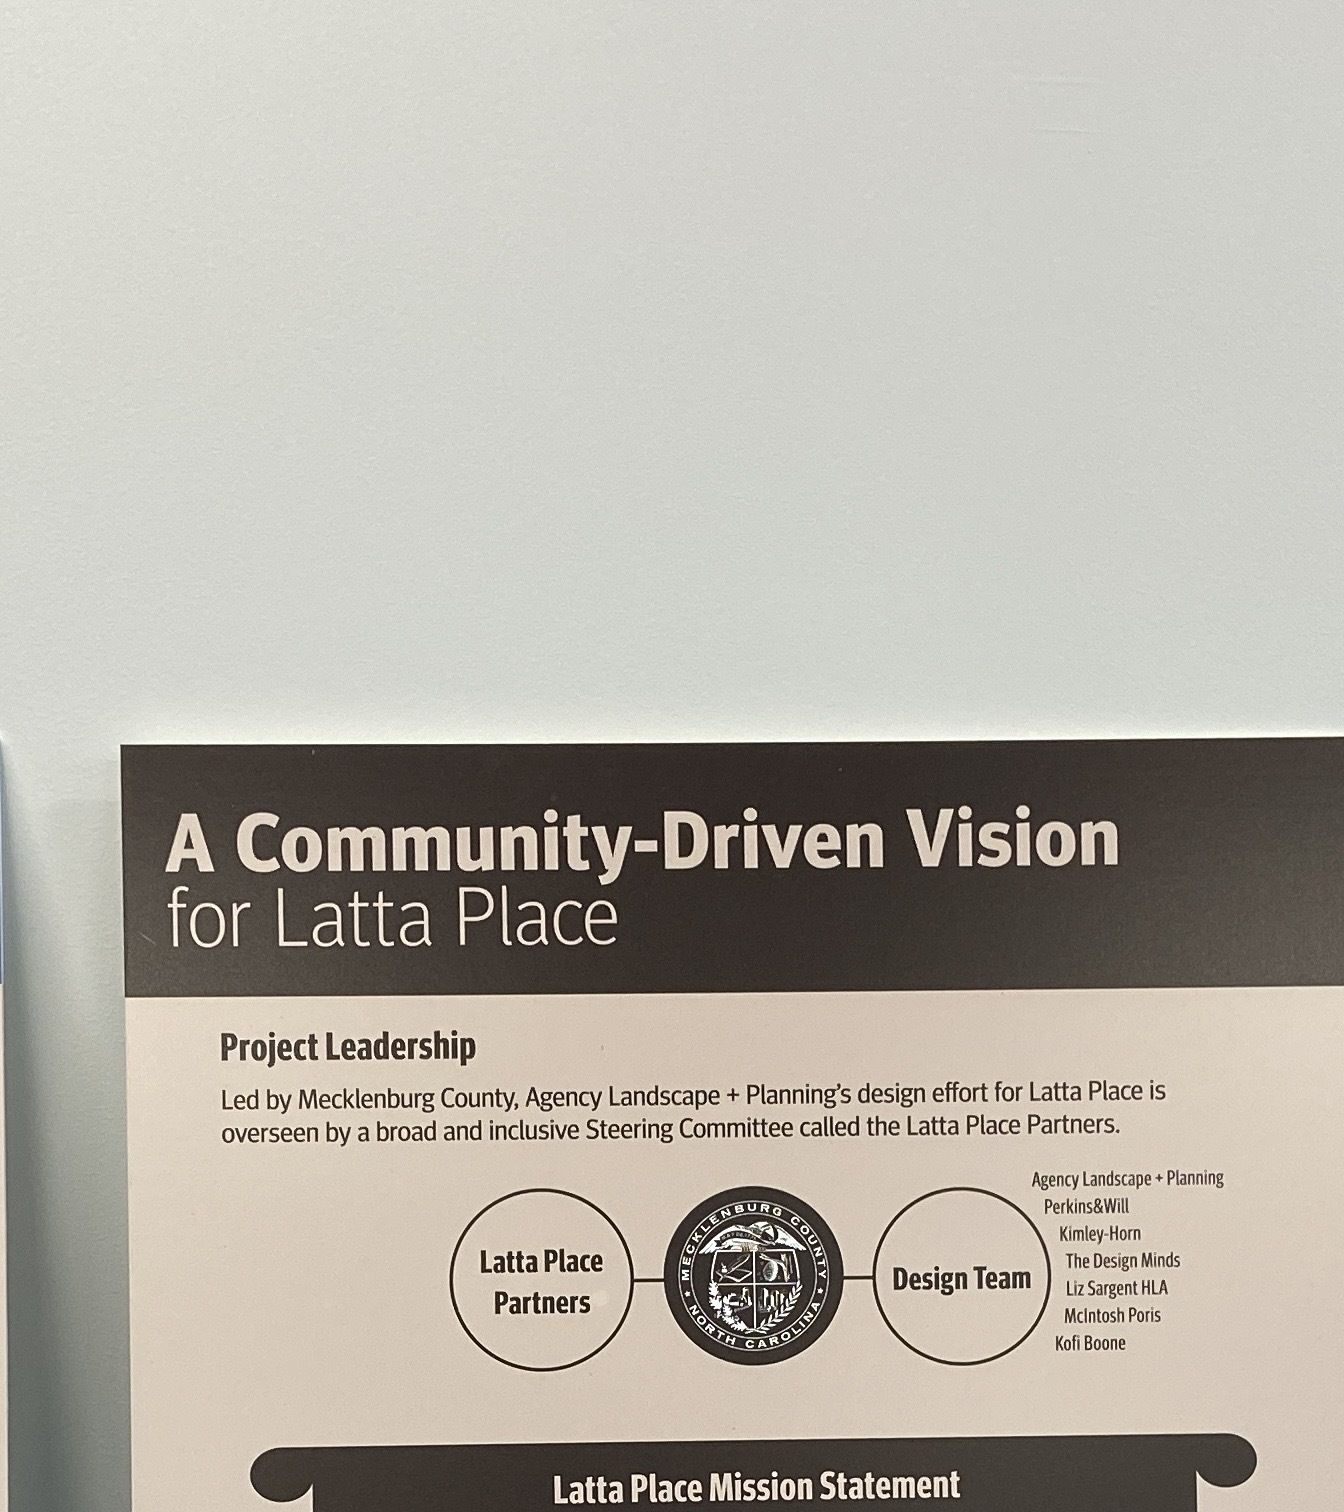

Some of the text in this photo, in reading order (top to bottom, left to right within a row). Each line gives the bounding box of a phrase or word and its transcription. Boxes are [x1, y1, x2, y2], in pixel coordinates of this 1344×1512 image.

[164, 806, 1118, 883] A Community-Driven Vision
[166, 884, 618, 948] for Latta Place
[1030, 1170, 1080, 1191] Agency
[1081, 1169, 1152, 1190] Landscape
[1166, 1168, 1225, 1189] Planning
[1043, 1196, 1130, 1215] Perkins&Will
[681, 1203, 827, 1281] MECKLENBURG COUNTY
[1058, 1224, 1141, 1245] Kimley-Horn
[479, 1247, 603, 1274] Latta Place
[892, 1264, 1031, 1296] Design Team
[493, 1289, 591, 1315] Partners
[689, 1302, 821, 1349] NORTH CAROLINA
[553, 1469, 961, 1505] Latta Place Mission Statement
